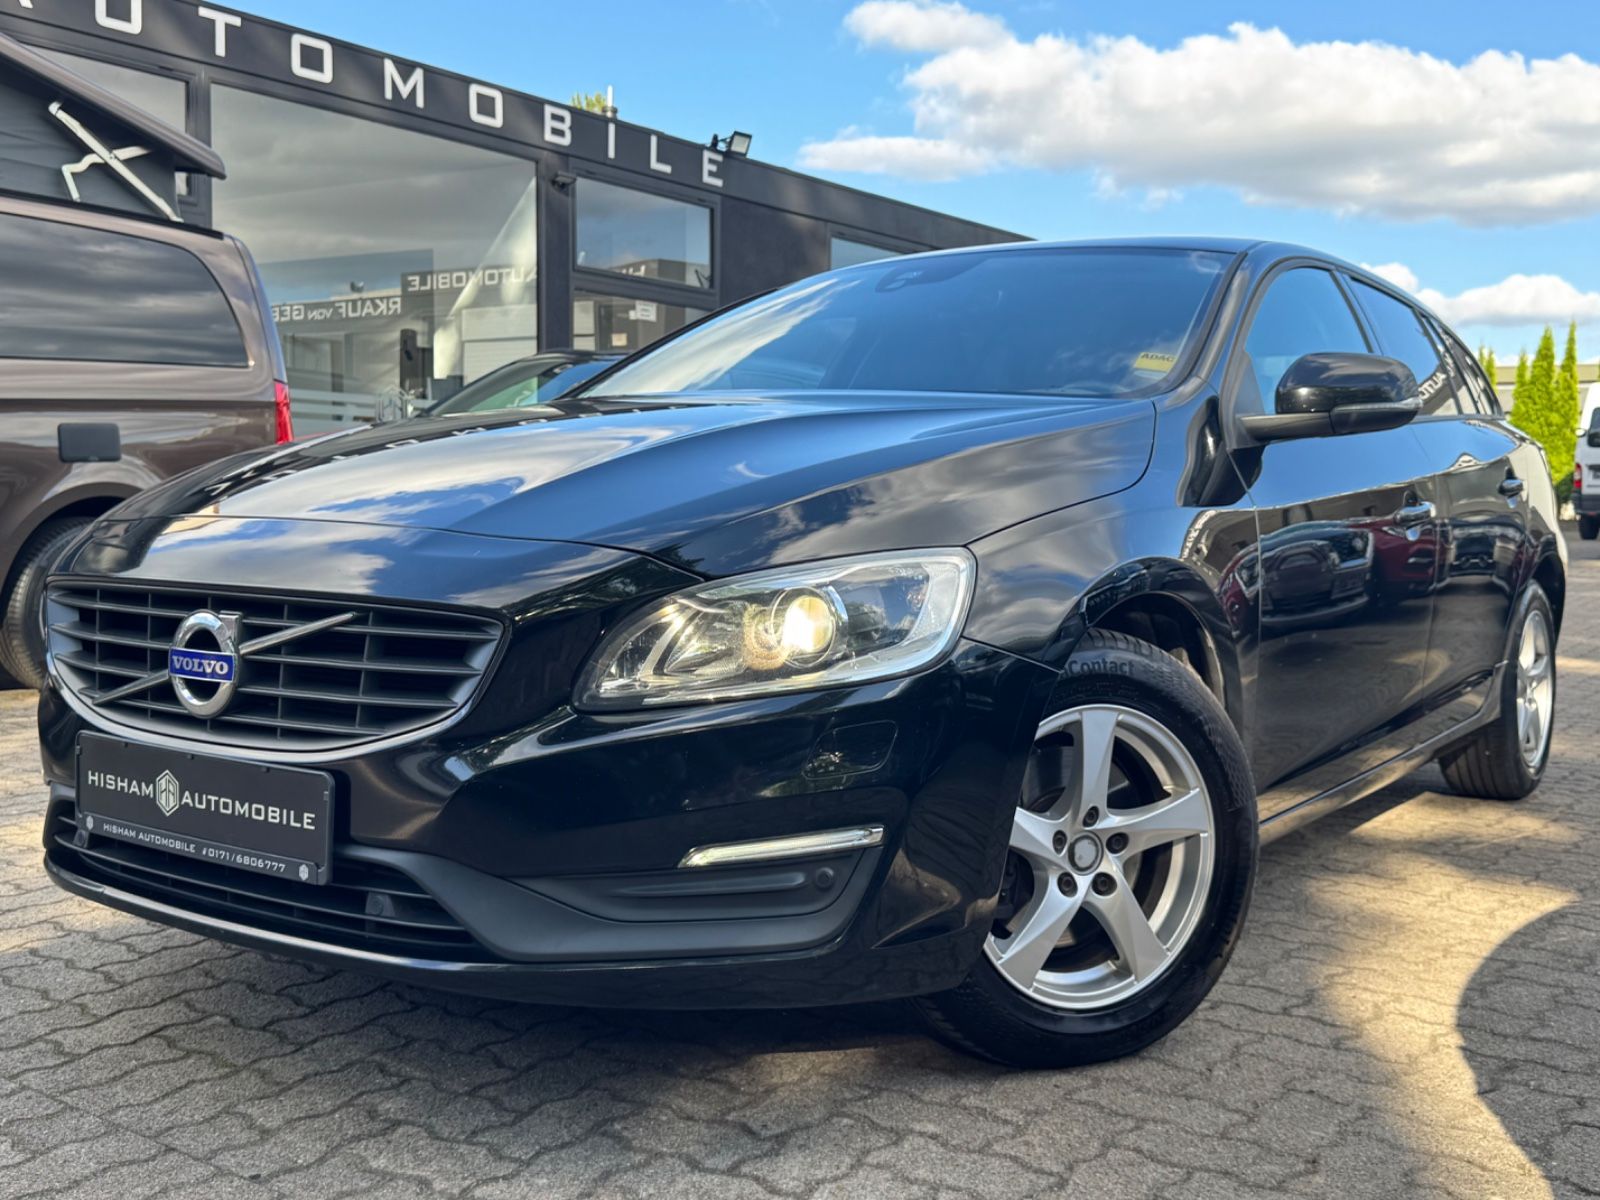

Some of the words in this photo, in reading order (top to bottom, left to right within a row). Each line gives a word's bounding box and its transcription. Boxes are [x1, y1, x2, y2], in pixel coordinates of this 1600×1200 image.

[16, 0, 724, 188] UTOMOBILE
[172, 655, 229, 675] VOLVO
[87, 770, 154, 798] HISHAM
[181, 790, 316, 830] AUTOMOBILE
[103, 823, 136, 839] HISHAM
[138, 831, 196, 853] AUTOMOBILE
